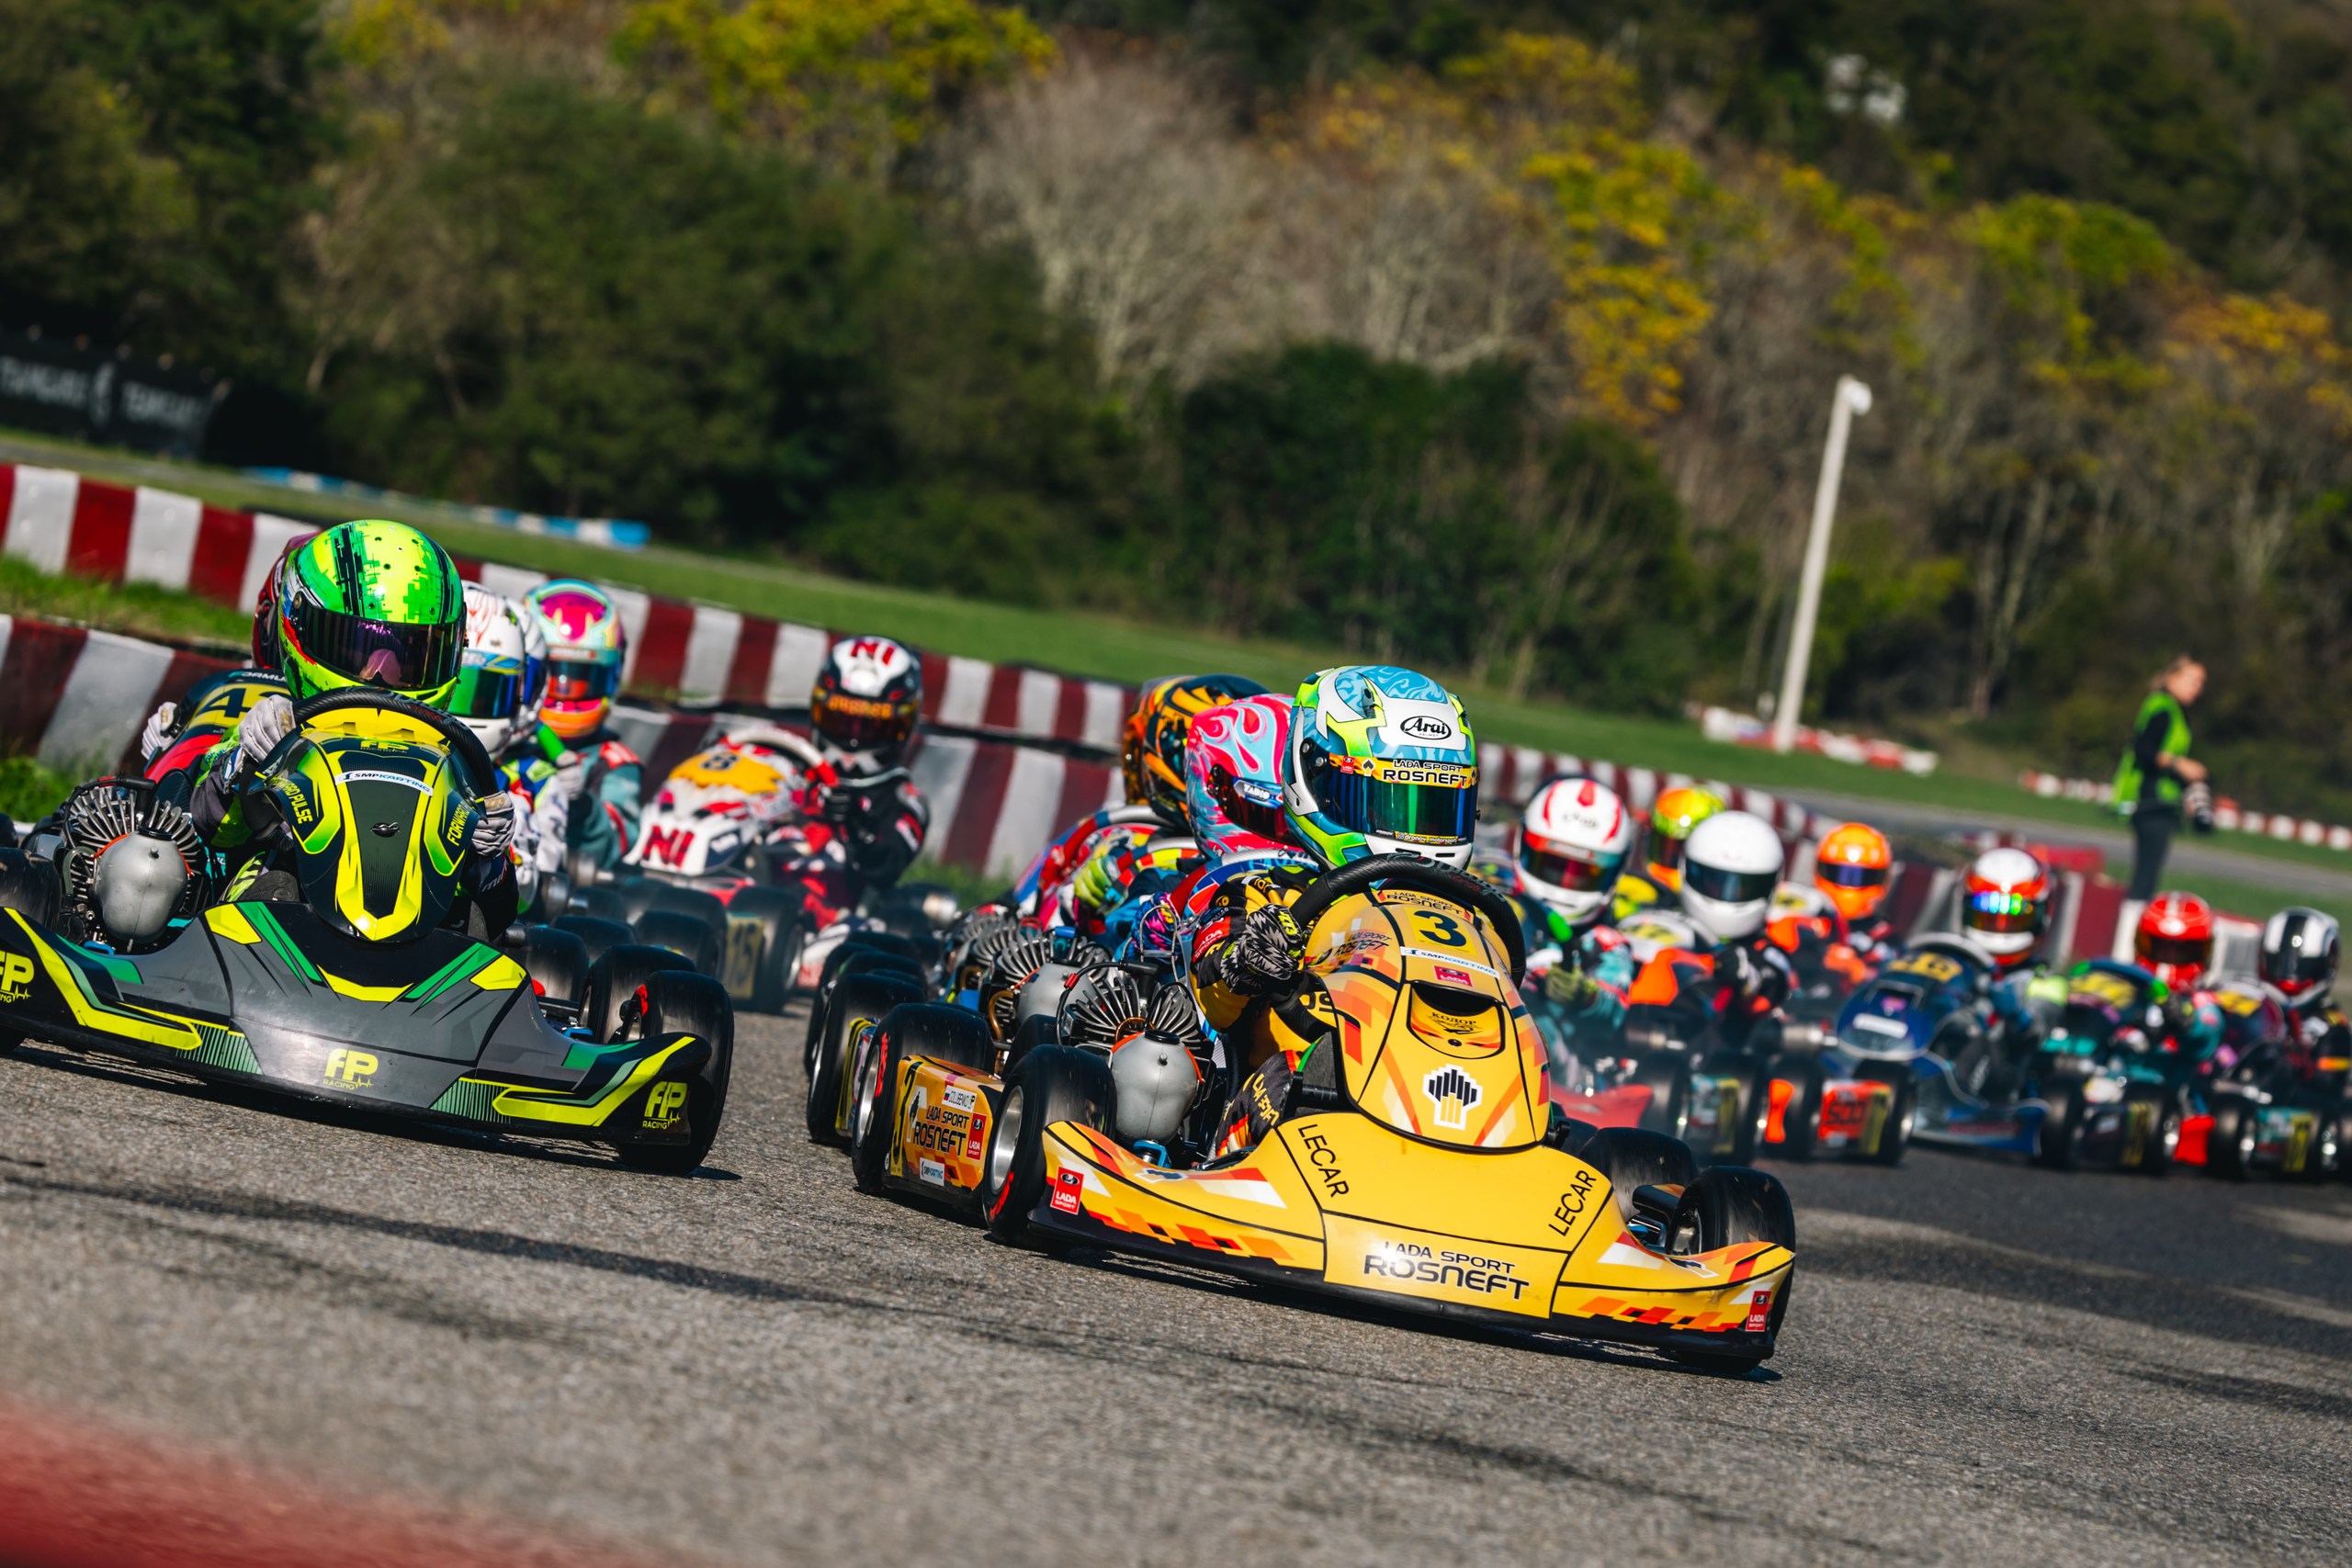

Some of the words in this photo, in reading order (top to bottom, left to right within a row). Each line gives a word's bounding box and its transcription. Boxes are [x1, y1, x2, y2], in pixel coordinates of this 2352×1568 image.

[197, 688, 293, 719] 4
[1405, 717, 1446, 735] Arai
[1394, 759, 1420, 769] LADA
[1424, 762, 1464, 773] SPORT
[1383, 769, 1468, 787] ROSNEFT
[288, 793, 313, 825] PULSE
[1385, 894, 1463, 915] ROSNEFT
[1413, 910, 1467, 947] 3
[1440, 975, 1469, 986] LADA
[323, 1078, 356, 1091] RACING
[642, 1121, 668, 1130] RACING
[926, 1105, 942, 1122] LADA
[941, 1110, 969, 1130] SPORT
[912, 1120, 967, 1156] ROSNEFT
[968, 1139, 980, 1151] LADA
[1297, 1123, 1350, 1198] LECAR
[1055, 1200, 1076, 1210] SPORT
[1056, 1190, 1077, 1204] LADA
[1548, 1169, 1597, 1236] LECAR
[1440, 1250, 1516, 1275] SPORT
[1363, 1253, 1531, 1301] ROSNEFT
